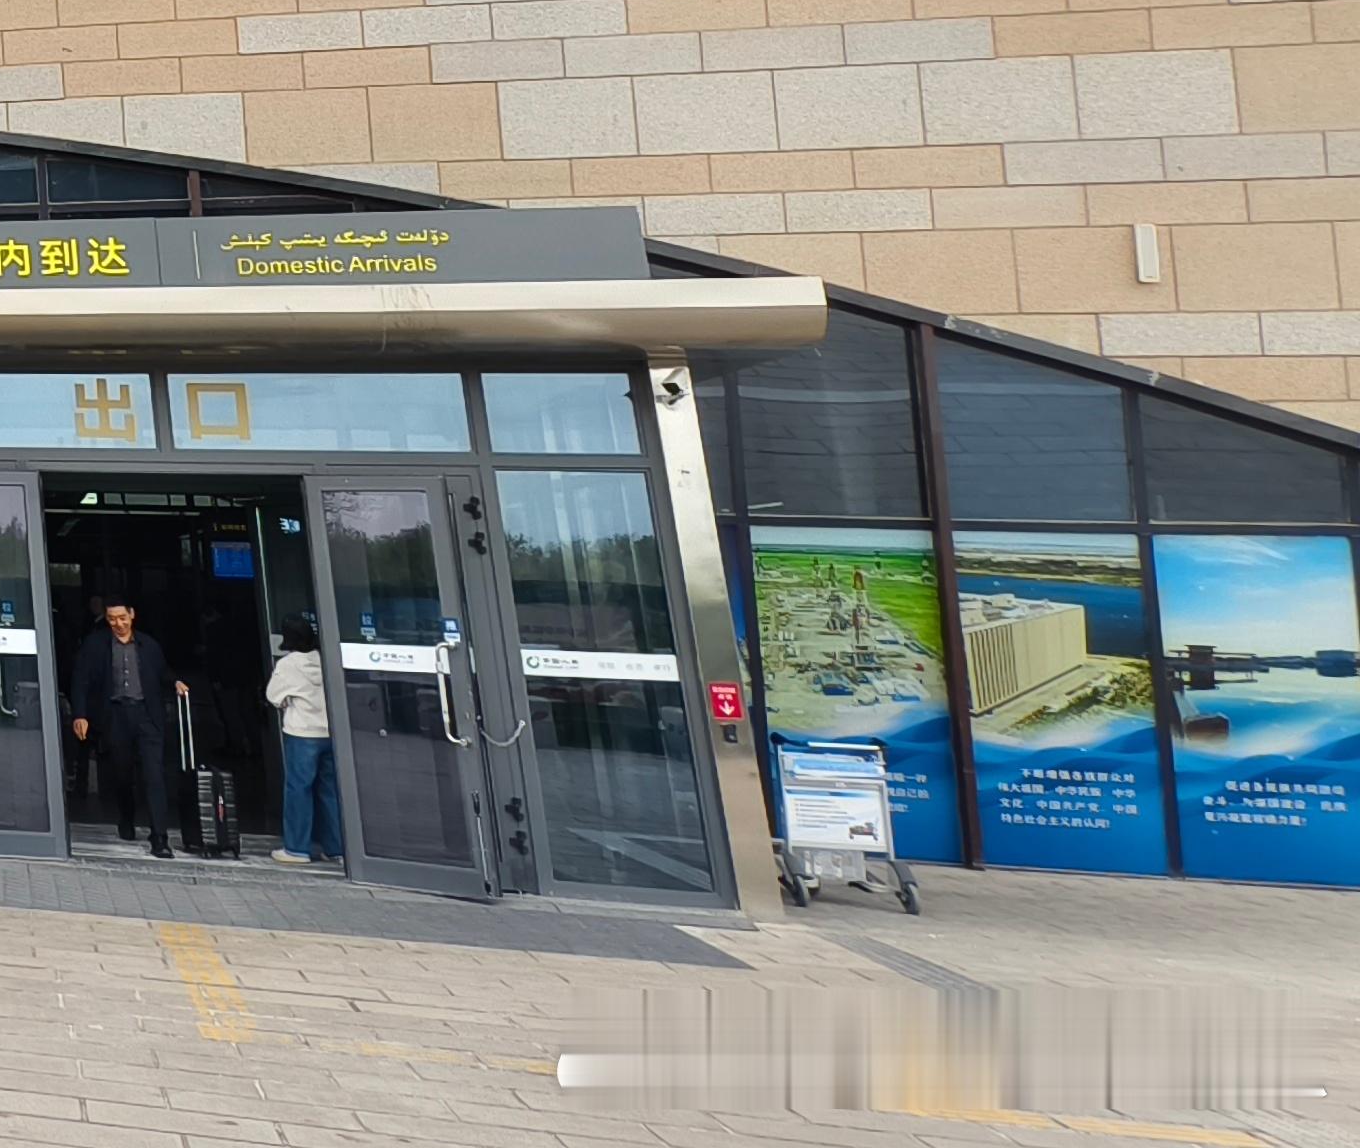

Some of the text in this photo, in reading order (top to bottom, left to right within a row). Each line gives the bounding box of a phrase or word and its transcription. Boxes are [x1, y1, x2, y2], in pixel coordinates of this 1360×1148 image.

[237, 254, 438, 275] Domestic Arrivals
[73, 377, 253, 444] 出口
